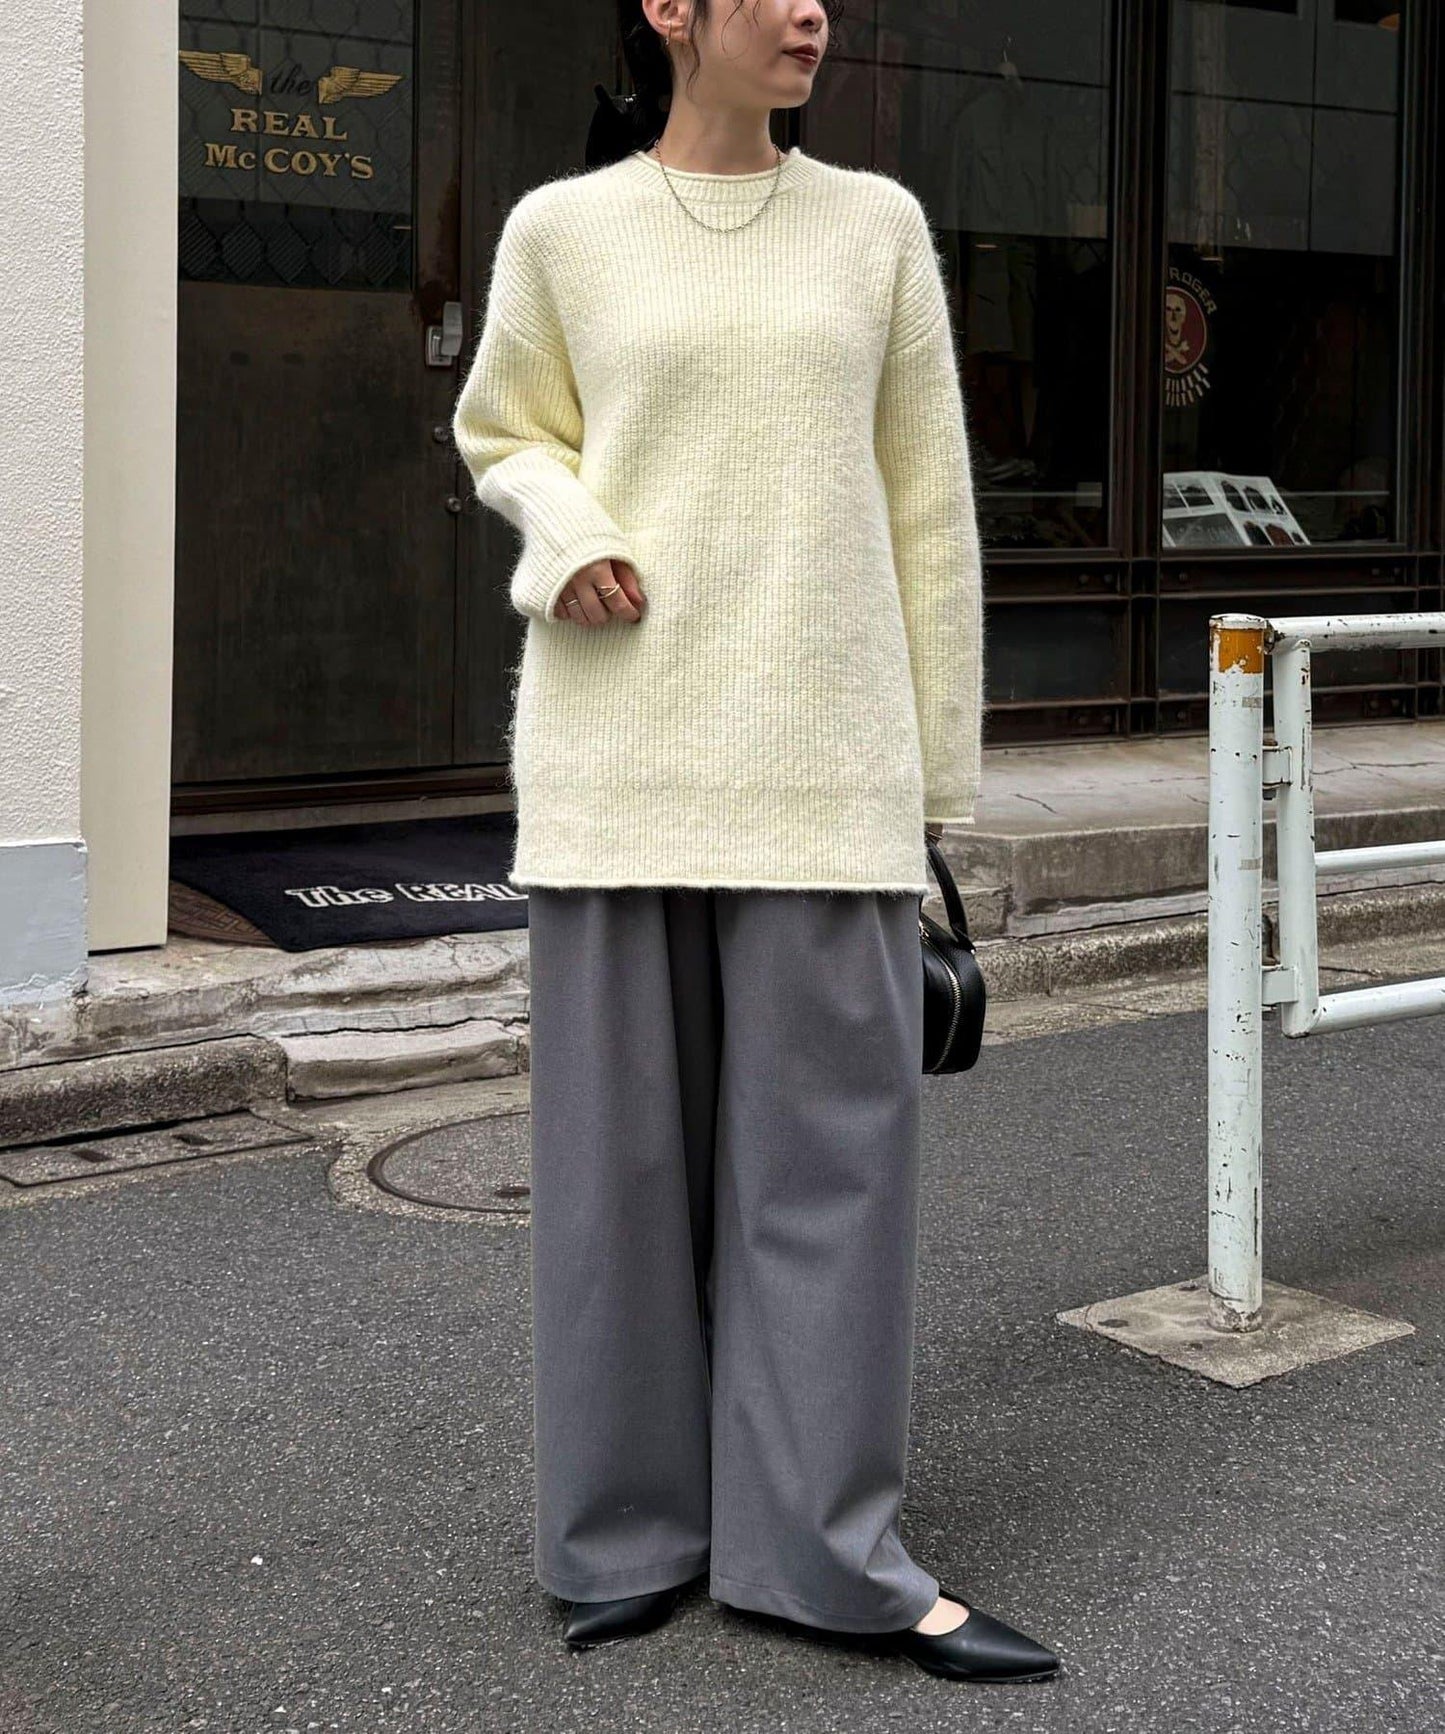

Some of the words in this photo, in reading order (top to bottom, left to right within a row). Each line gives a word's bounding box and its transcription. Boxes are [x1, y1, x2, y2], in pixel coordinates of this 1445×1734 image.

[270, 62, 313, 95] the
[230, 107, 348, 141] REAL
[1168, 266, 1218, 315] ROGER
[285, 884, 395, 908] The
[395, 882, 529, 902] REAL
